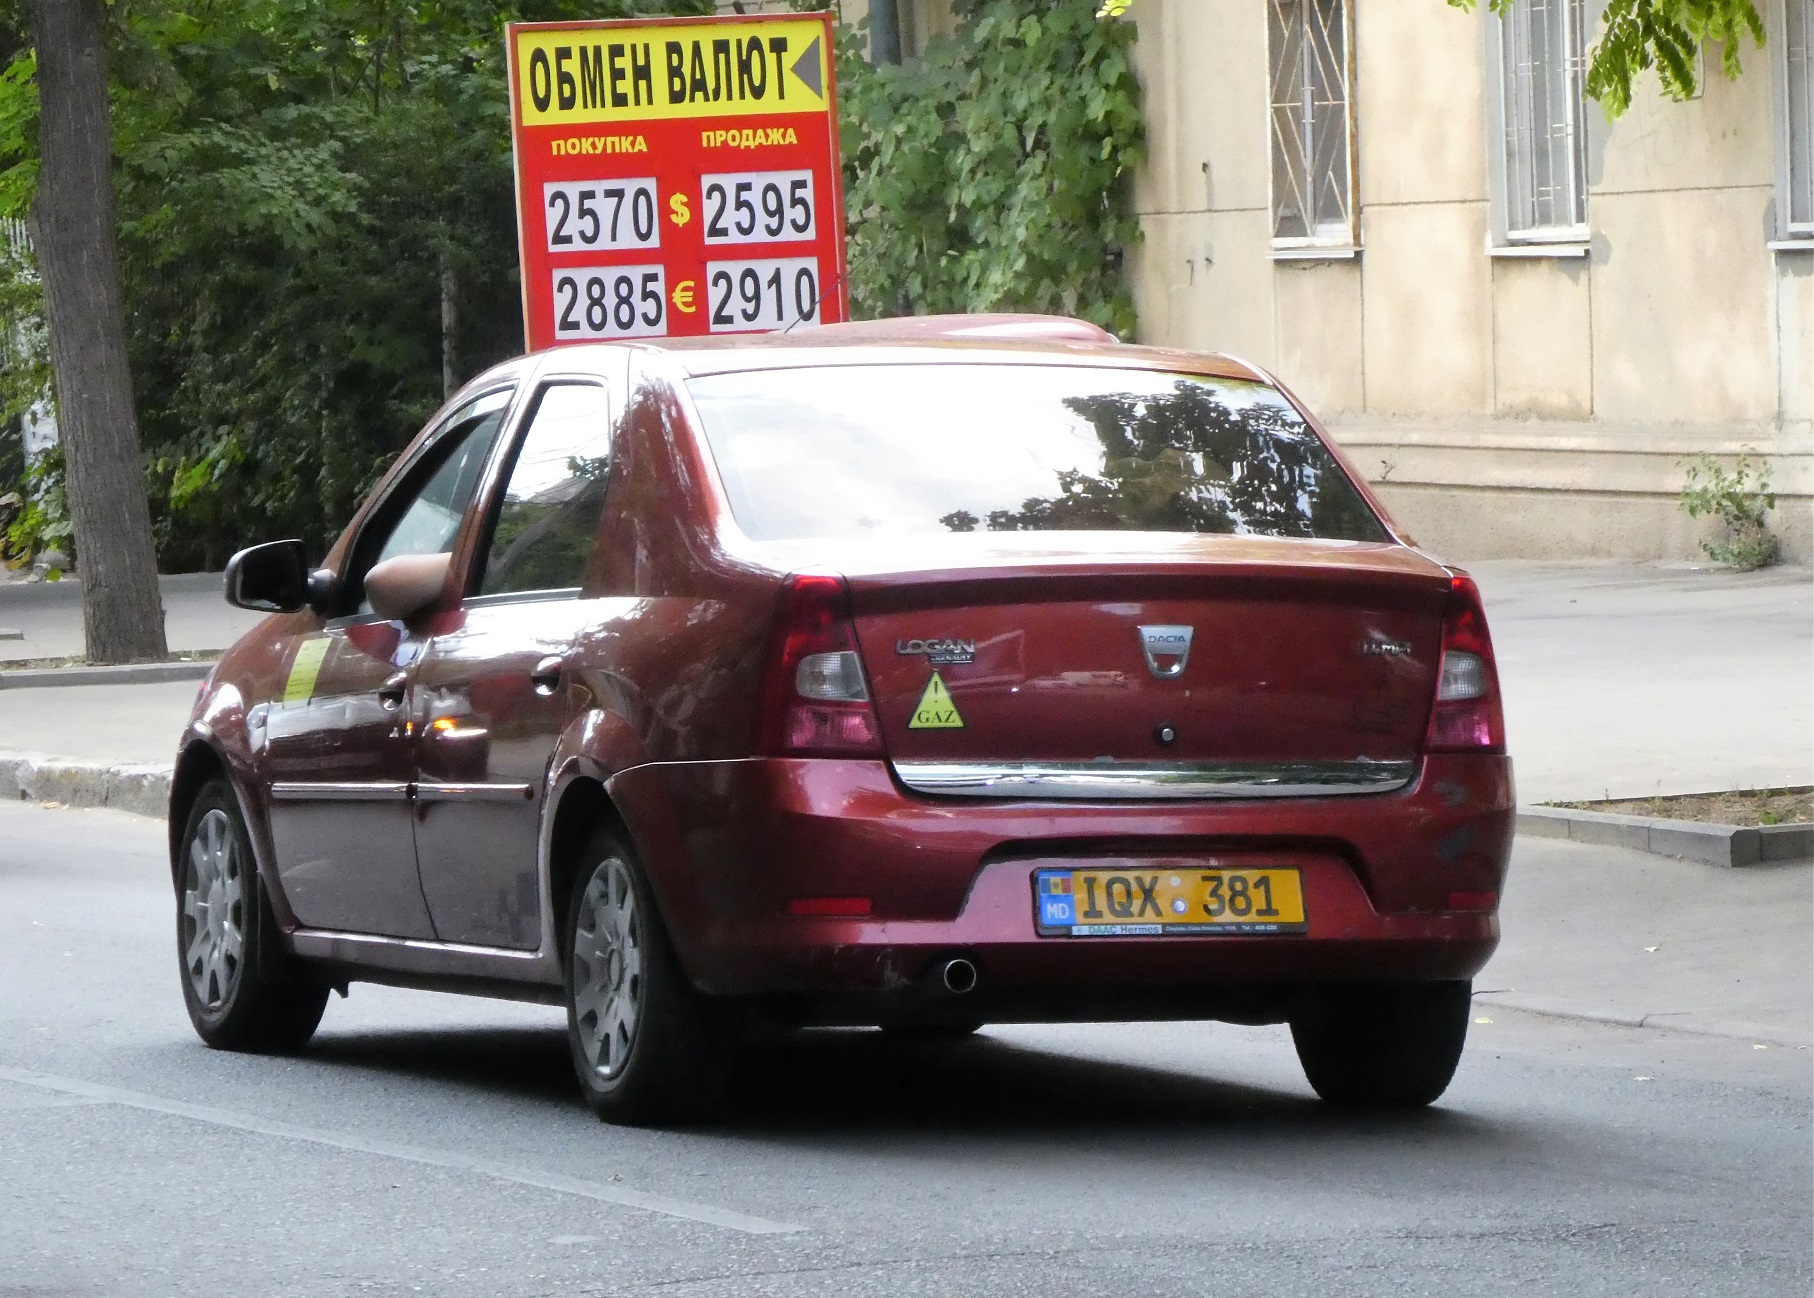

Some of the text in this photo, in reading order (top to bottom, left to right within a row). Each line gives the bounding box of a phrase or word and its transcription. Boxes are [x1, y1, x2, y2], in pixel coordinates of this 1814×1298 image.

[529, 35, 788, 112] ОБМЕН ВАЛЮТ
[551, 135, 648, 156] ПОКУПКА
[701, 127, 798, 149] ПРОДАЖА
[548, 179, 812, 246] 2570 $ 2595
[556, 266, 817, 332] 2885 € 2910
[896, 639, 975, 654] LOGAN
[1148, 635, 1186, 643] DACIA
[917, 710, 956, 724] GAZ
[1083, 875, 1280, 919] IQX 381
[1046, 902, 1070, 920] MD
[1088, 925, 1117, 935] DAAC
[1120, 925, 1160, 934] Hermes
